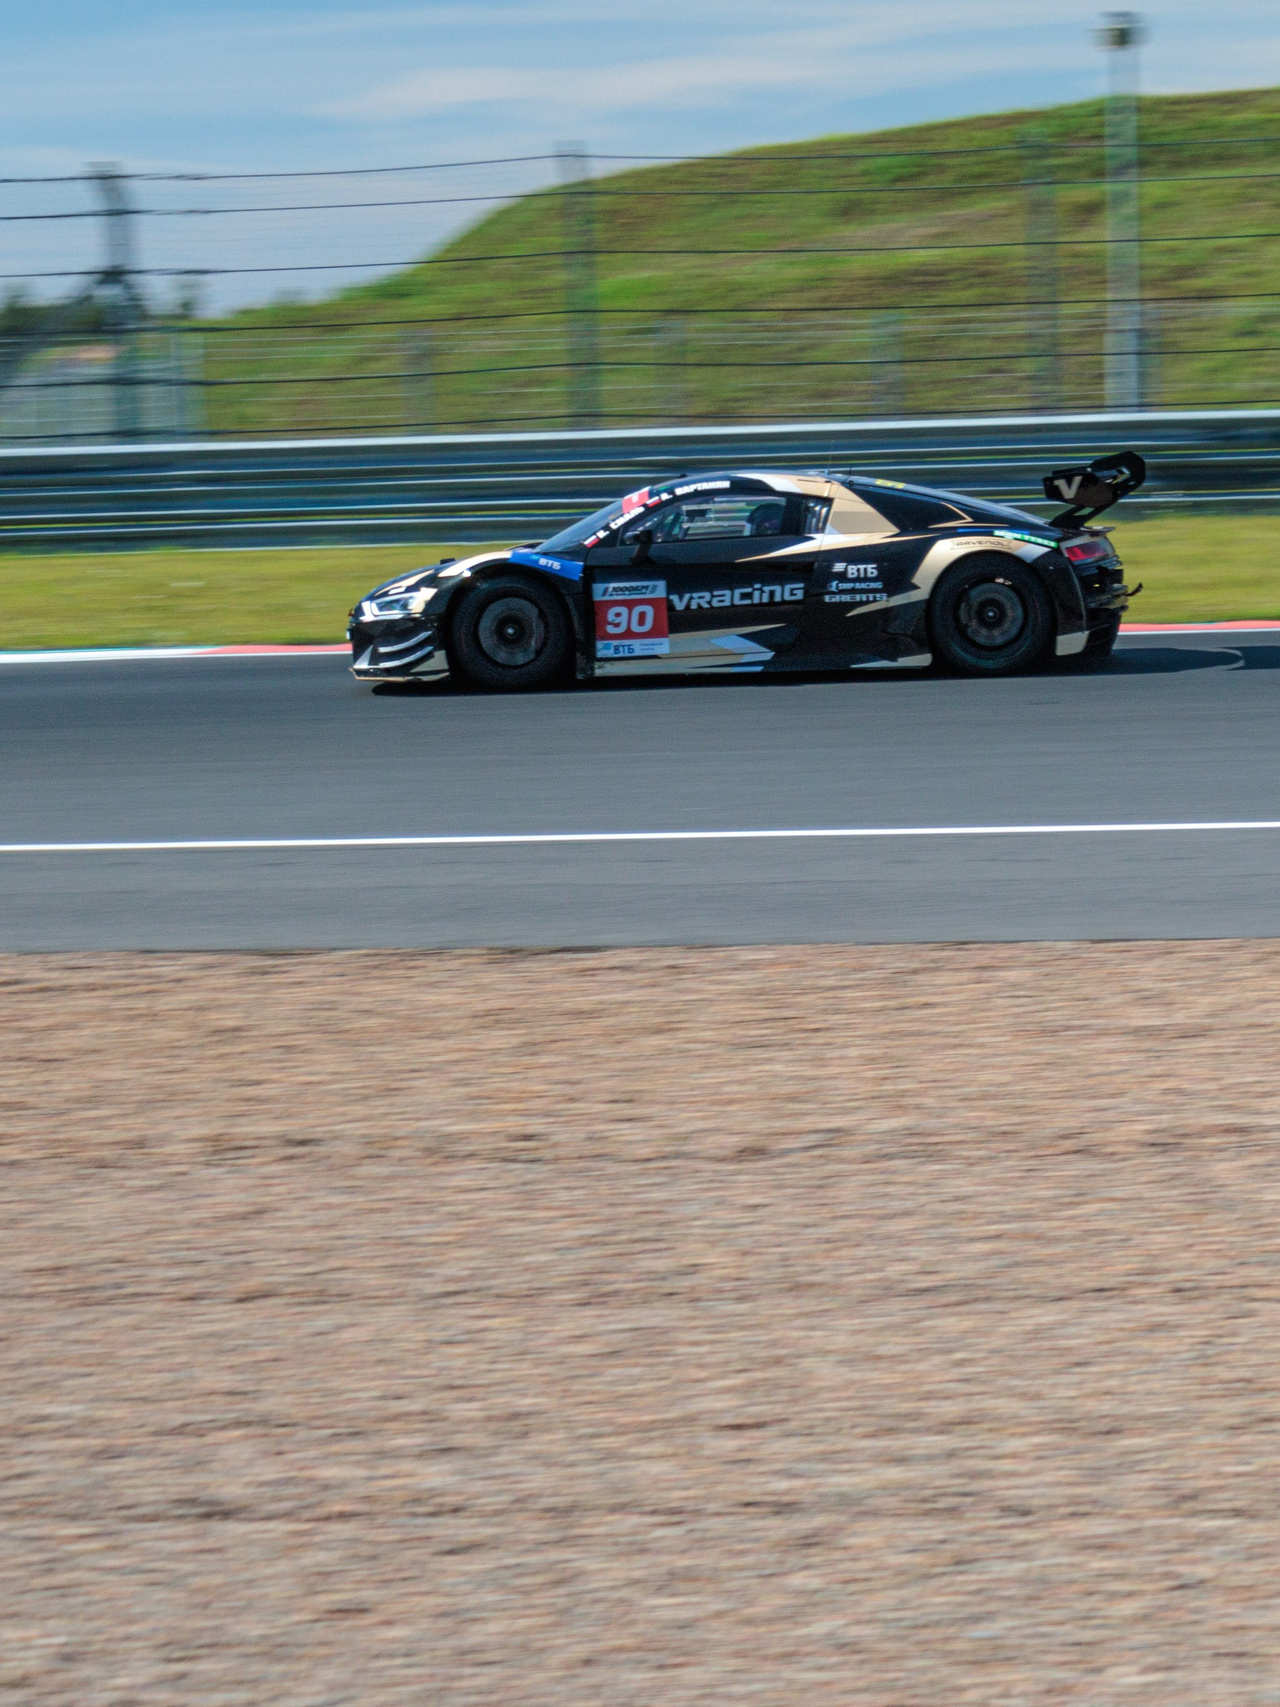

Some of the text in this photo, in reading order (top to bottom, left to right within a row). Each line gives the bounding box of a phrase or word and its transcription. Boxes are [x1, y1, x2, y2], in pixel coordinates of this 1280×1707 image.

[847, 564, 878, 578] ВТБ
[606, 605, 655, 634] 90
[613, 644, 635, 655] ВТБ
